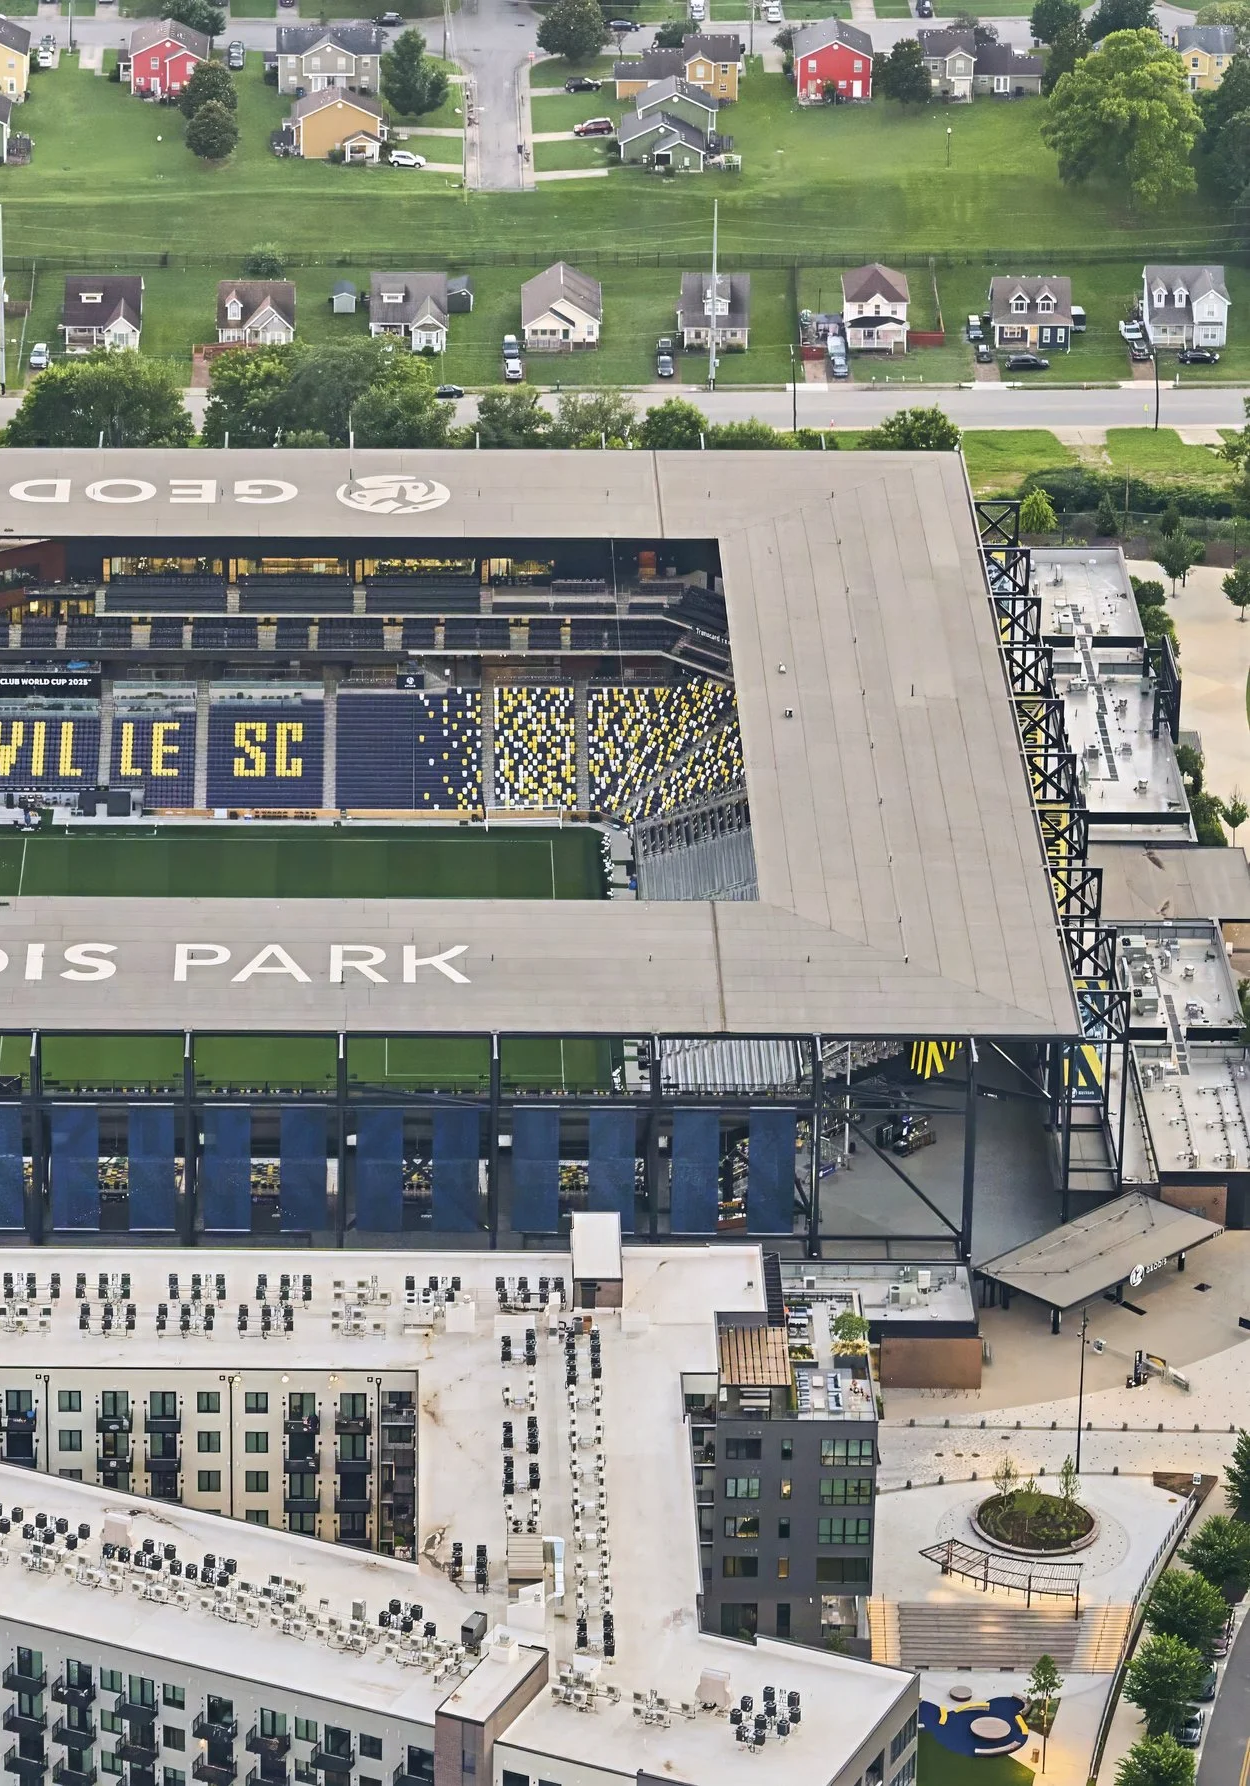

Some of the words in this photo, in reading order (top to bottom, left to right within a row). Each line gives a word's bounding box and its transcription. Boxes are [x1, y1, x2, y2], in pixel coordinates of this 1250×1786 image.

[0, 678, 20, 686] CLUB
[21, 678, 50, 686] WORLD
[51, 678, 68, 686] CUP
[233, 721, 304, 778] SC
[172, 944, 471, 984] PARK
